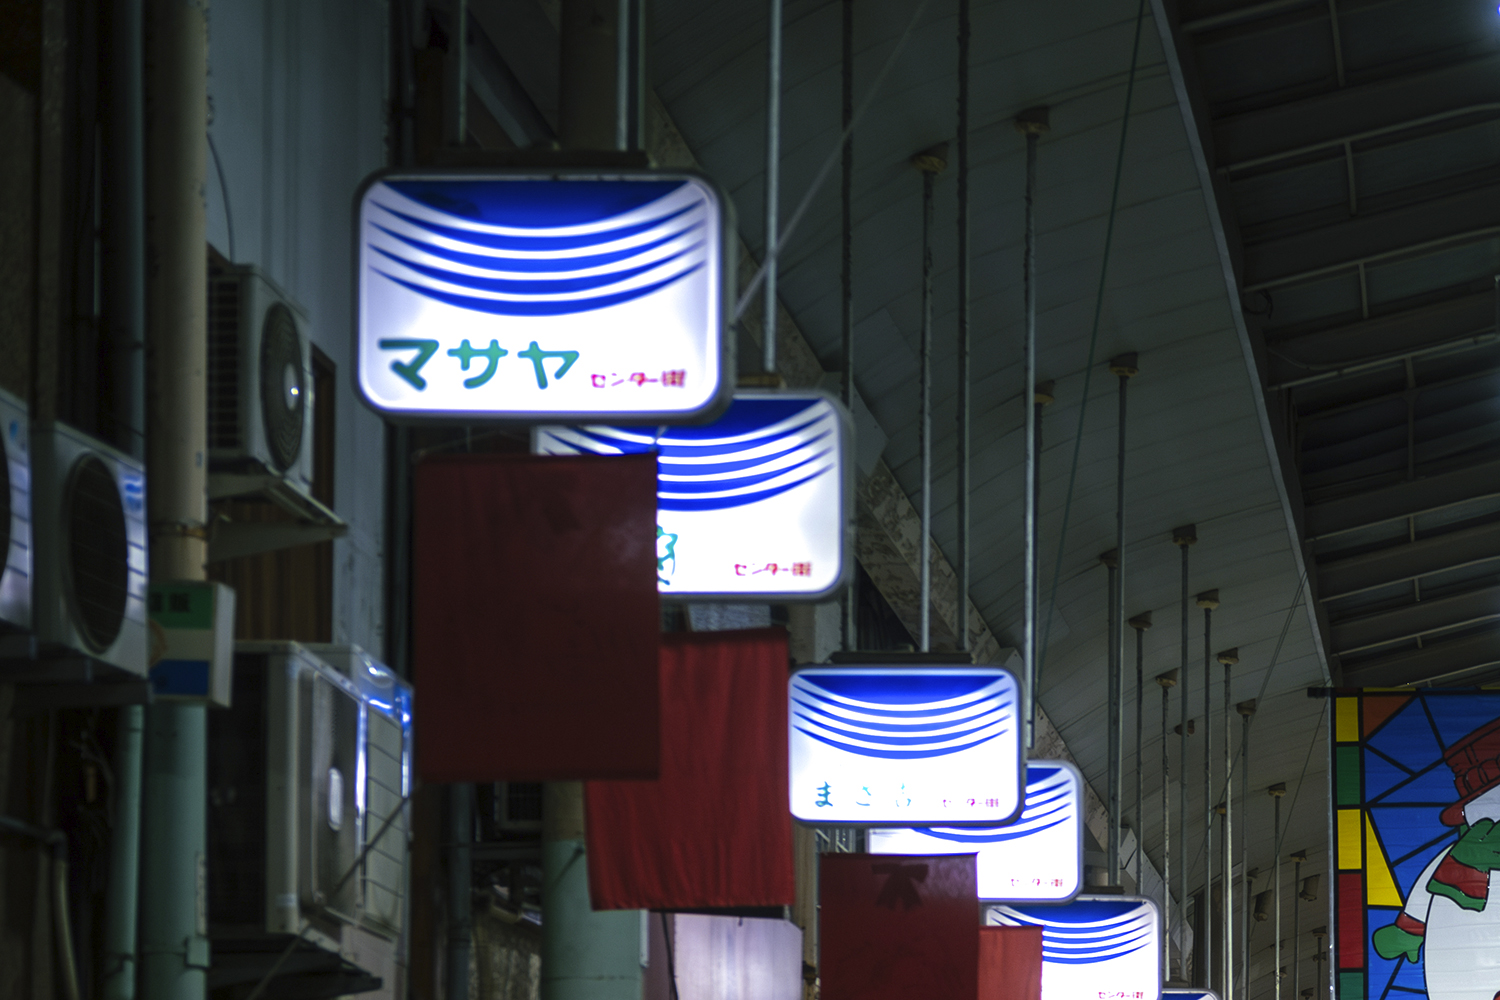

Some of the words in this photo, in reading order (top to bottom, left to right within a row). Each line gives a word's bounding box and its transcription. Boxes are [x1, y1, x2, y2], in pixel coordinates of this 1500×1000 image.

[377, 338, 580, 391] マサヤ
[591, 369, 686, 388] センター街
